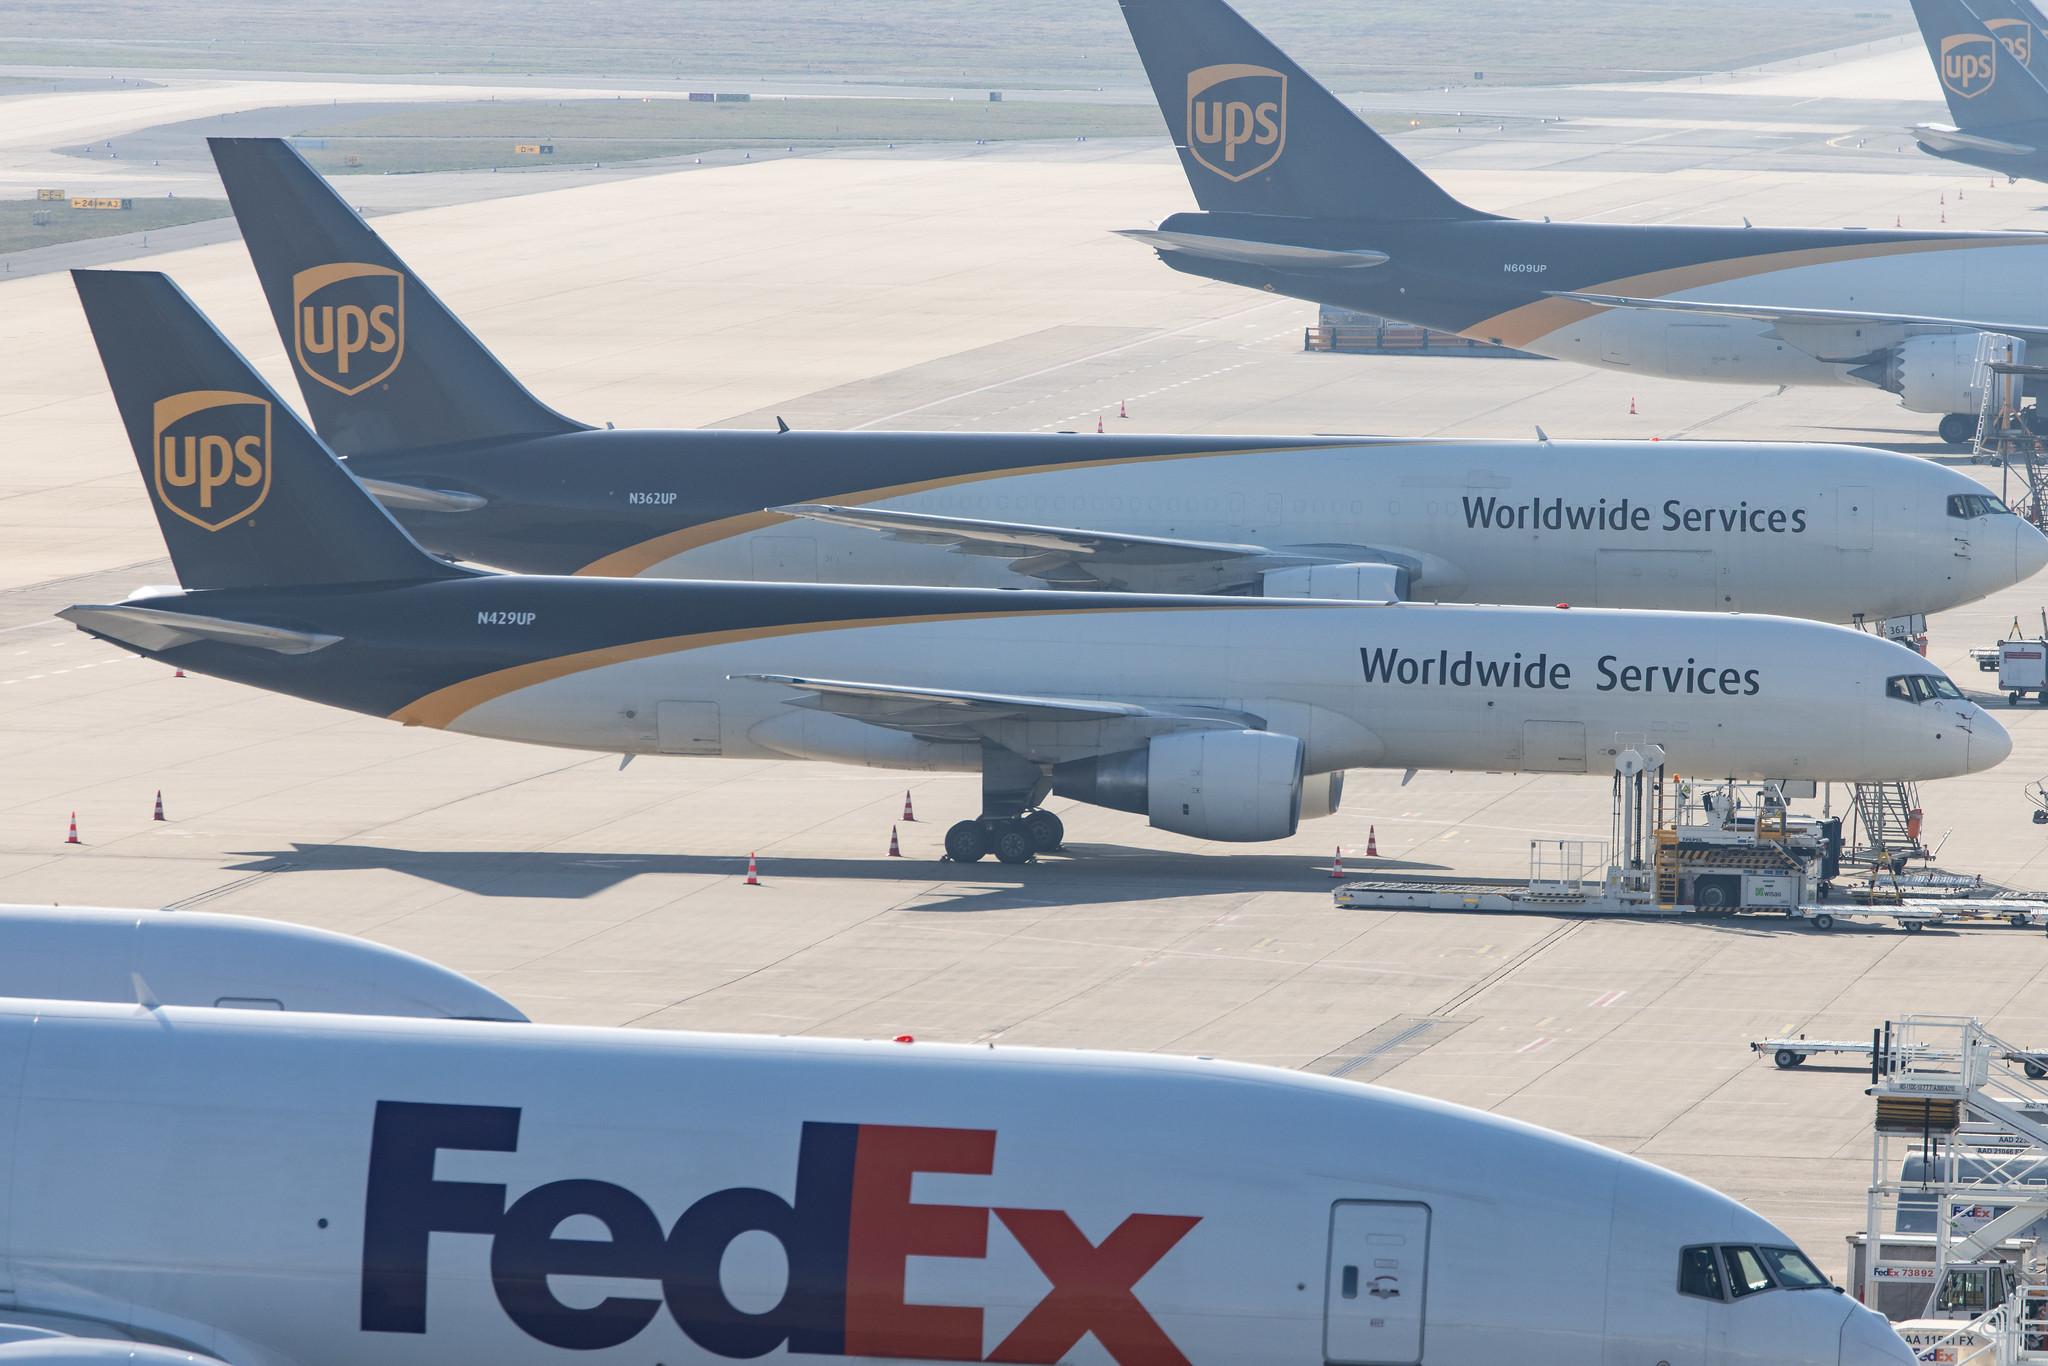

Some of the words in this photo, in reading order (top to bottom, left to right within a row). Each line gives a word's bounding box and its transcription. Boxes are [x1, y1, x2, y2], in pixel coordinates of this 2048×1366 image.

[1946, 54, 1991, 88] ups
[1195, 101, 1279, 162] ups
[1503, 263, 1547, 273] N609UP
[303, 304, 396, 374] ups
[163, 434, 263, 509] ups
[629, 492, 678, 505] N362UP
[1462, 496, 1651, 531] Worldwide
[1662, 499, 1808, 534] Services
[477, 611, 537, 625] N429UP
[1890, 625, 1905, 635] 362
[1359, 647, 1572, 690] Worldwide
[1596, 655, 1761, 697] Services
[360, 1099, 1204, 1366] FedEx
[1873, 1267, 1900, 1277] FedEx
[1902, 1269, 1934, 1277] 73892
[1959, 1336, 1974, 1346] FX
